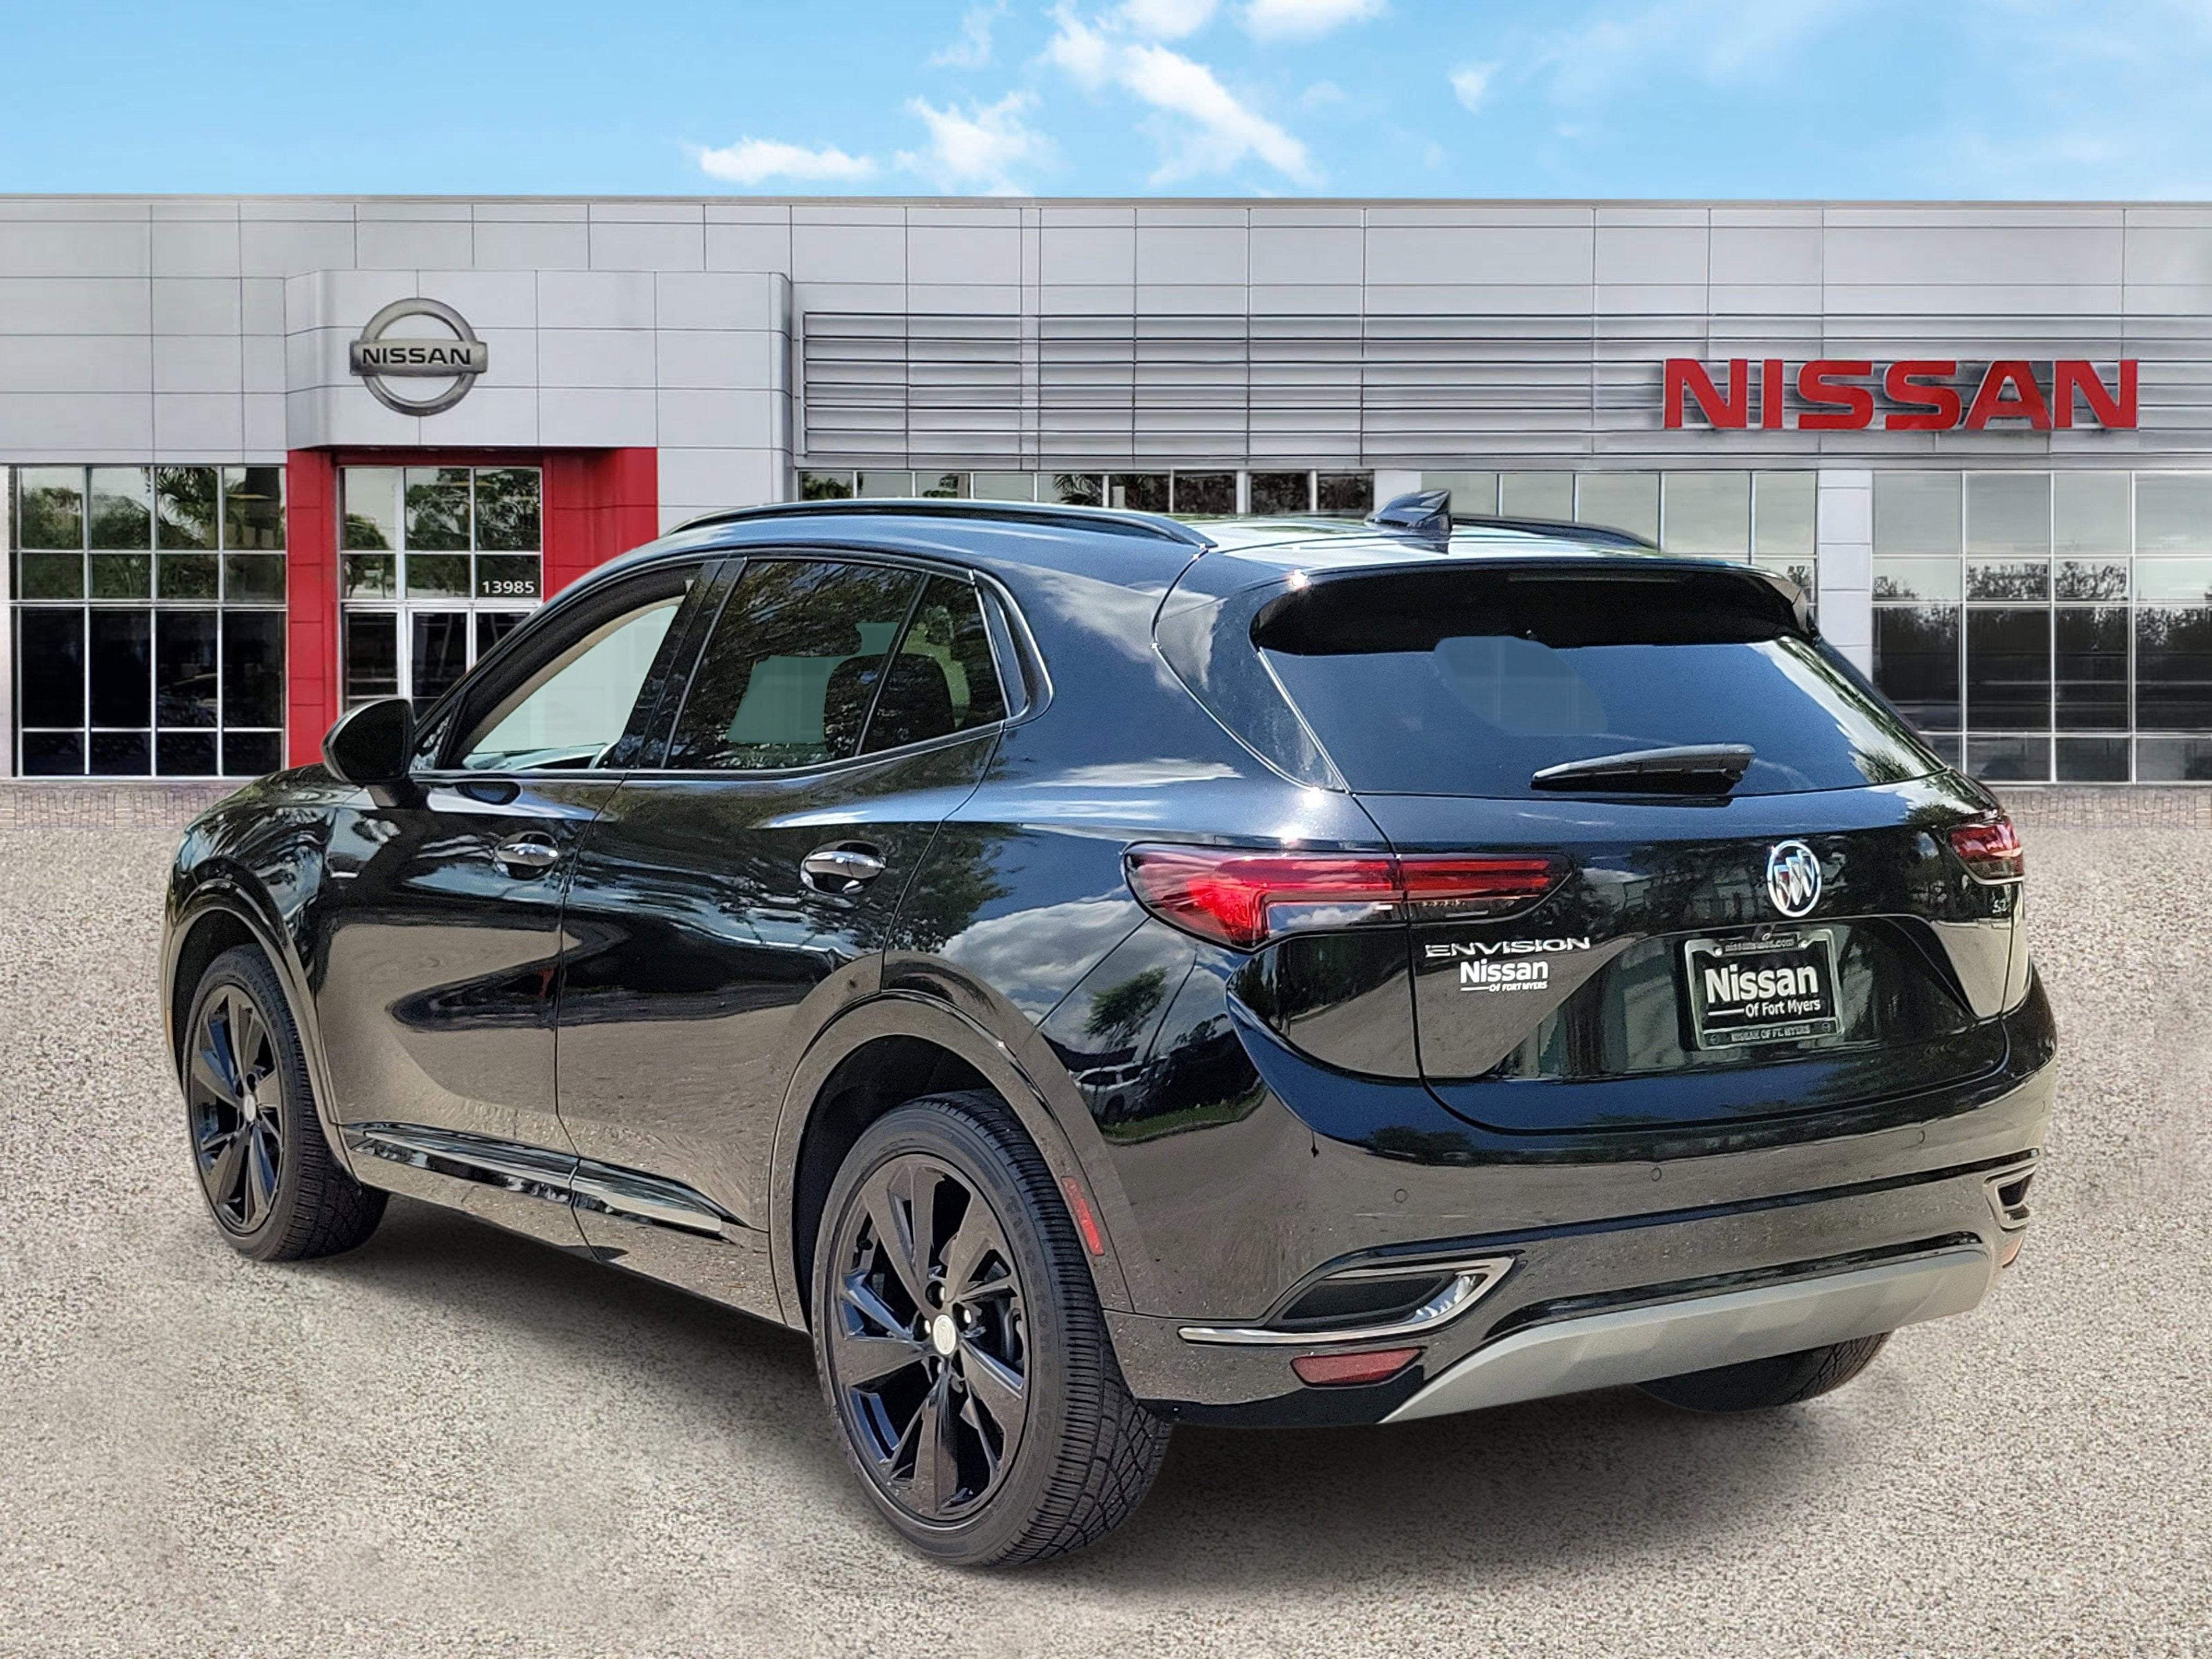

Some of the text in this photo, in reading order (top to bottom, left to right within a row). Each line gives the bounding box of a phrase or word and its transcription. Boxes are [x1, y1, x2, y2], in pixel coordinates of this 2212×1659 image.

[363, 348, 471, 365] NISSAN
[1663, 358, 2138, 430] NISSAN
[482, 580, 534, 594] 13985
[1425, 937, 1590, 957] ENVISION
[1460, 958, 1548, 983] Nissan
[1705, 964, 1818, 1003] Nissan
[1745, 999, 1821, 1018] Of Fort Myers
